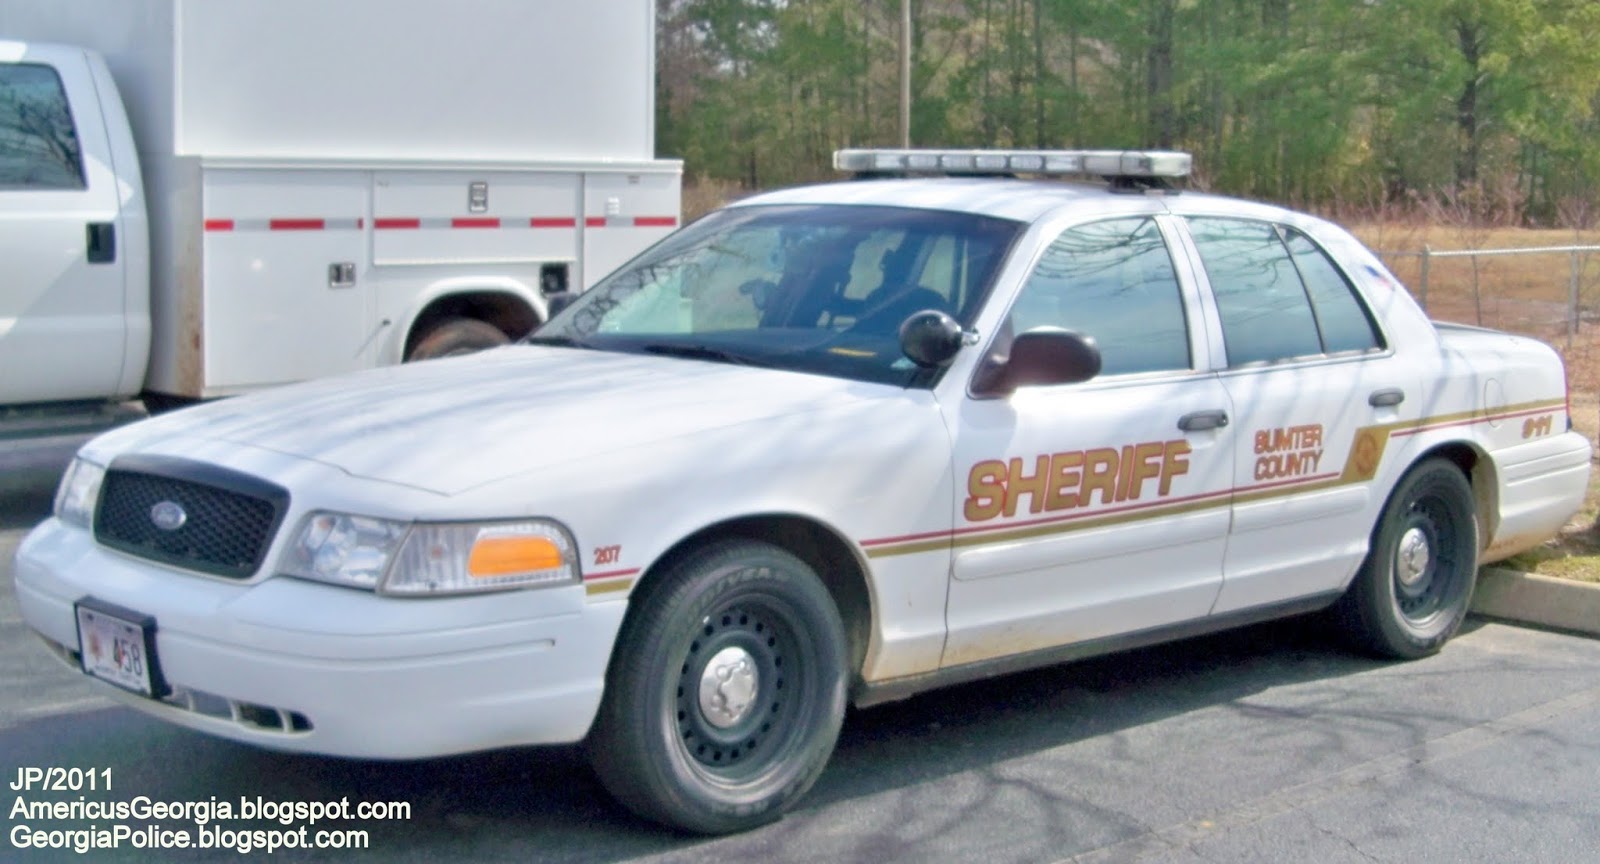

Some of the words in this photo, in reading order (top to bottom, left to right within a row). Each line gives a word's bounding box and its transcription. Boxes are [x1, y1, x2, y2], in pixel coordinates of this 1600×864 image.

[1254, 424, 1323, 454] SUMTER
[963, 438, 1192, 522] SHERIFF
[1254, 450, 1324, 480] COUNTY
[593, 545, 622, 566] 207
